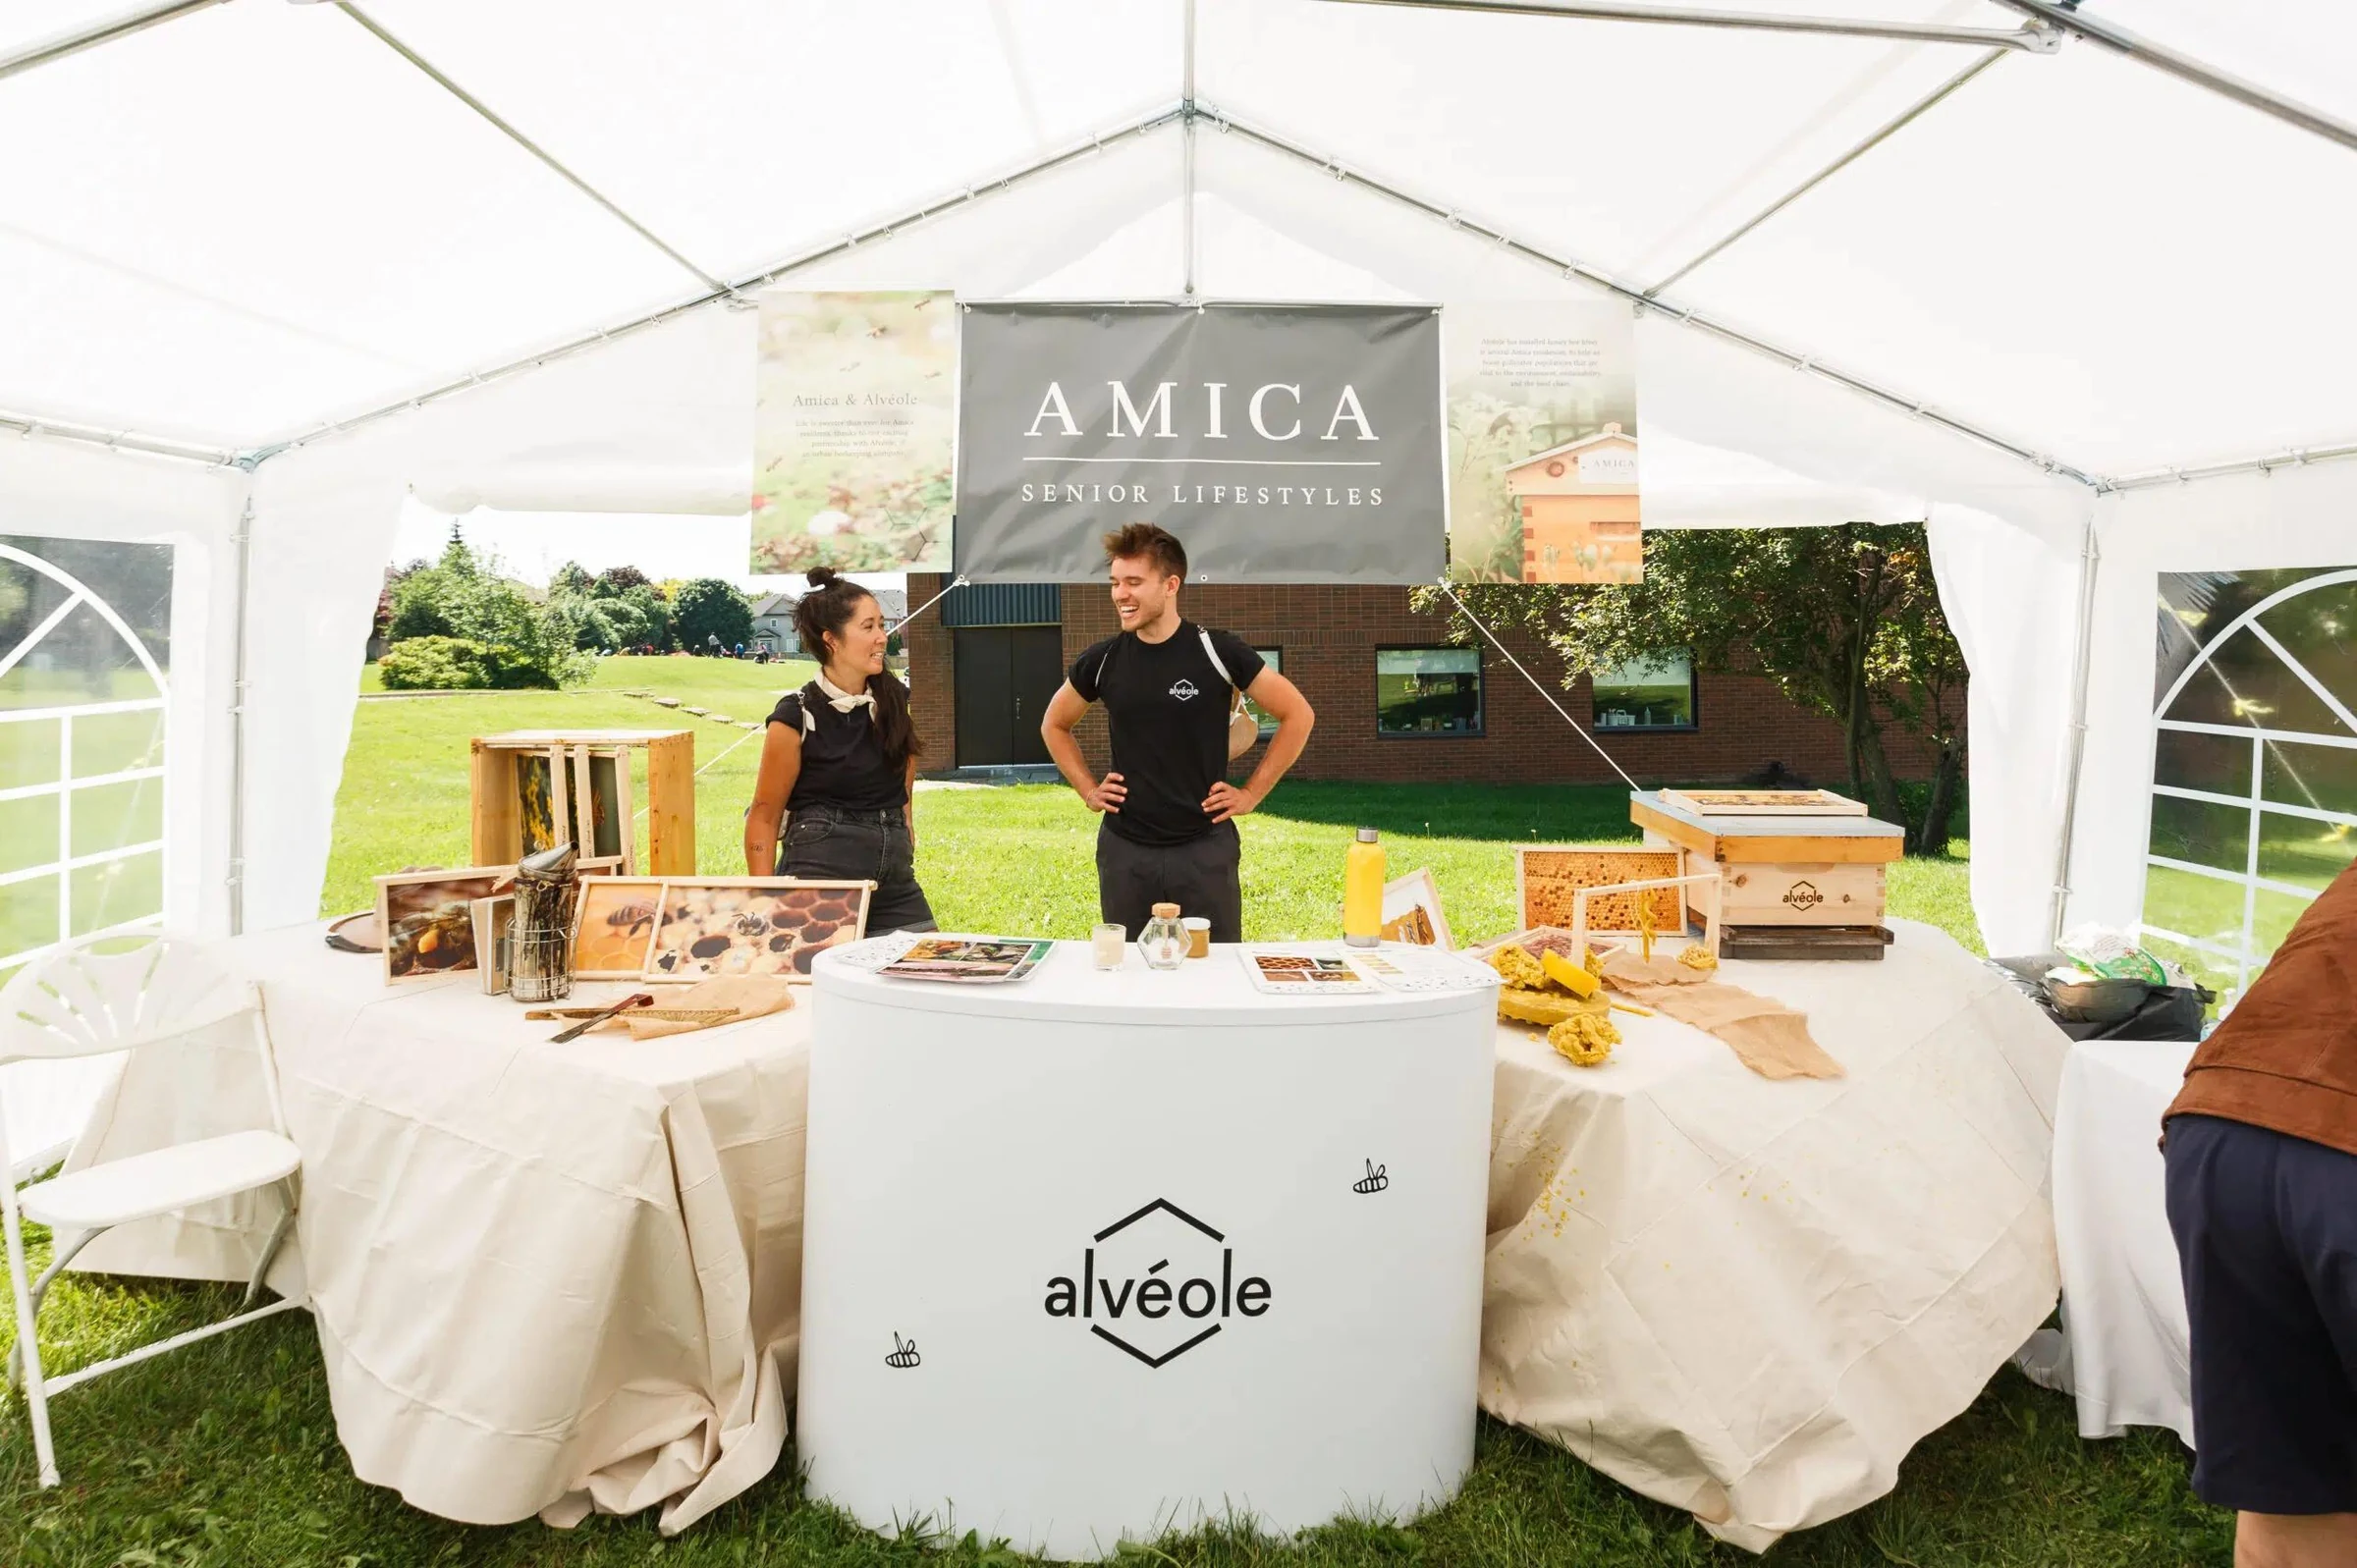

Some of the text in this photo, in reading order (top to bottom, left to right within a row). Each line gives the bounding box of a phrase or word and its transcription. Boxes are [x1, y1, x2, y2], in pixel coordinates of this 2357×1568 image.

[793, 392, 918, 406] Amica & Alvéole
[1022, 380, 1380, 441] AMICA
[1593, 459, 1634, 468] AMICA
[1021, 482, 1383, 507] SENIOR LIFESTYLES
[1169, 684, 1199, 695] alvéole
[1782, 889, 1824, 903] alvéole
[1044, 1247, 1273, 1320] alvéole
